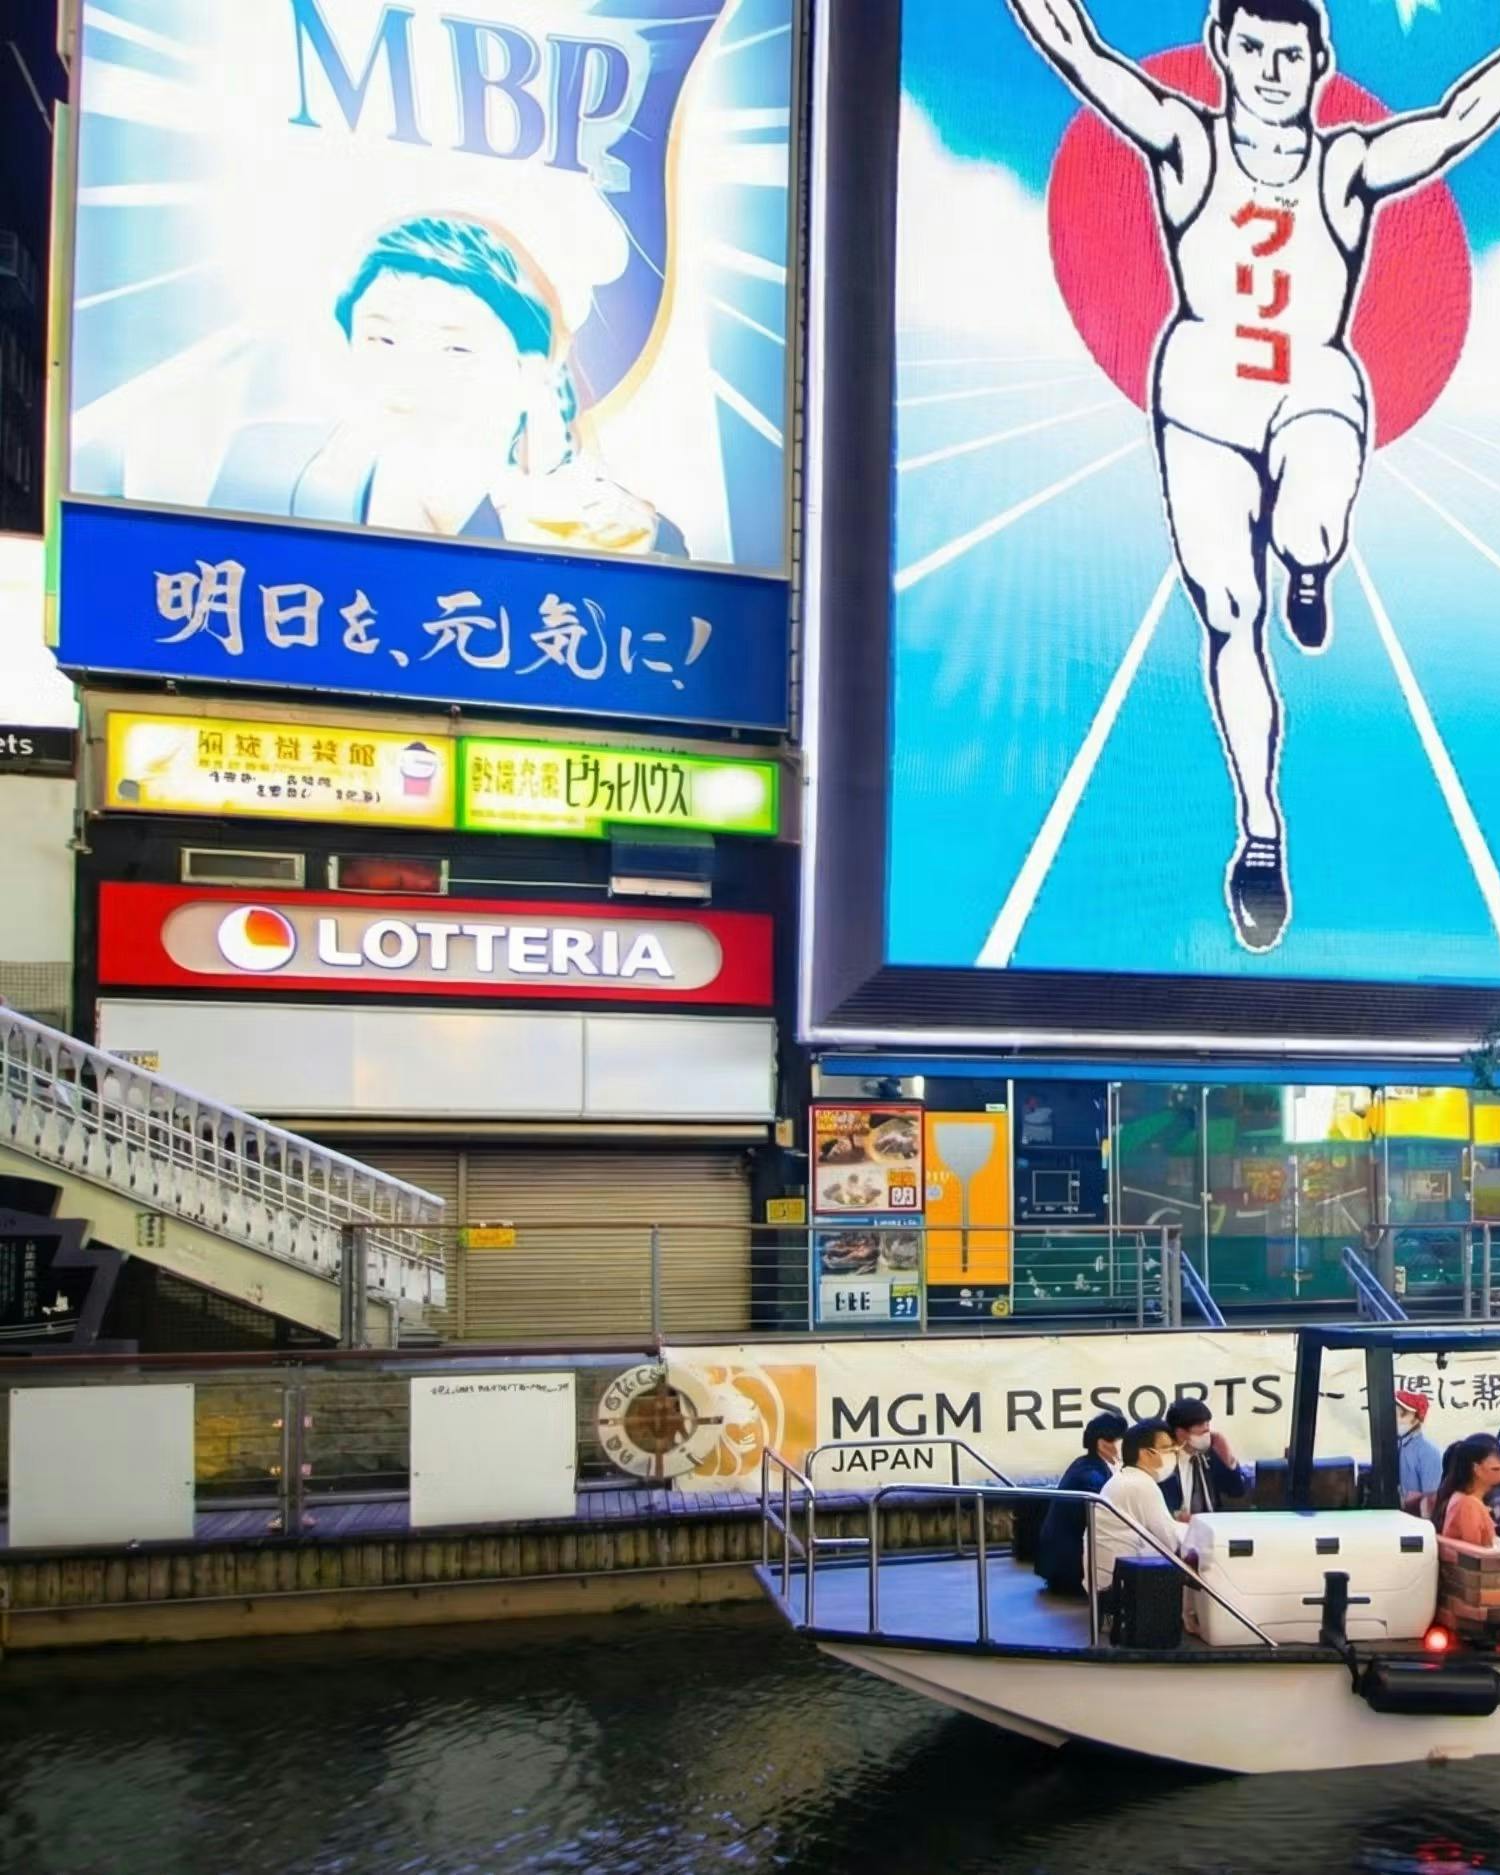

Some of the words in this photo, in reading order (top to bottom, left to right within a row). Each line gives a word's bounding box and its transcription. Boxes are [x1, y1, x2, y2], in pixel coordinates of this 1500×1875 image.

[317, 919, 675, 979] LOTTERIA
[832, 1391, 982, 1440] MGM
[832, 1447, 934, 1474] JAPAN
